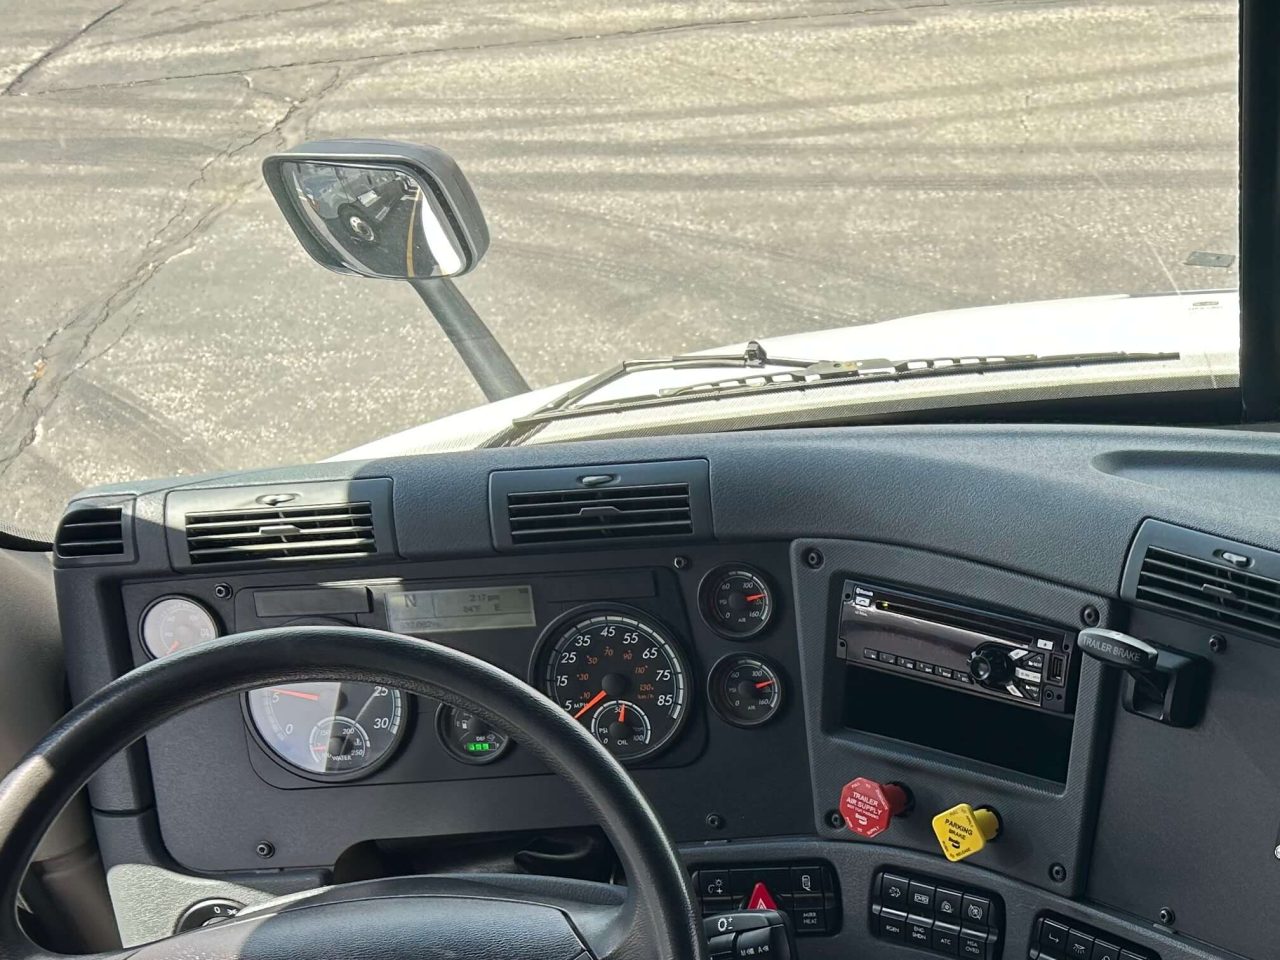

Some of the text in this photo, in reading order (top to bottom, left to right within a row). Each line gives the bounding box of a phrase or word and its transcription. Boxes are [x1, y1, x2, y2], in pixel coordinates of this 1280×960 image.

[404, 594, 417, 608] N
[600, 626, 616, 637] 45
[575, 635, 591, 646] 35
[622, 632, 638, 644] 55
[642, 648, 658, 659] 65
[1083, 636, 1141, 661] TRAILER BRAKE
[560, 652, 576, 663] 25
[556, 675, 568, 686] 15
[655, 670, 671, 681] 75
[374, 686, 388, 696] 25
[272, 692, 280, 703] 5
[656, 694, 673, 706] 85
[564, 700, 572, 711] 5
[373, 718, 389, 729] 30
[286, 724, 294, 735] 0
[853, 792, 879, 806] TRAILER
[846, 796, 882, 816] AIR SUPPLY
[944, 818, 973, 836] PARKING
[948, 829, 966, 840] BRAKE
[886, 925, 900, 933] RGEN
[912, 932, 926, 940] SHDN
[966, 946, 979, 954] OVRD
